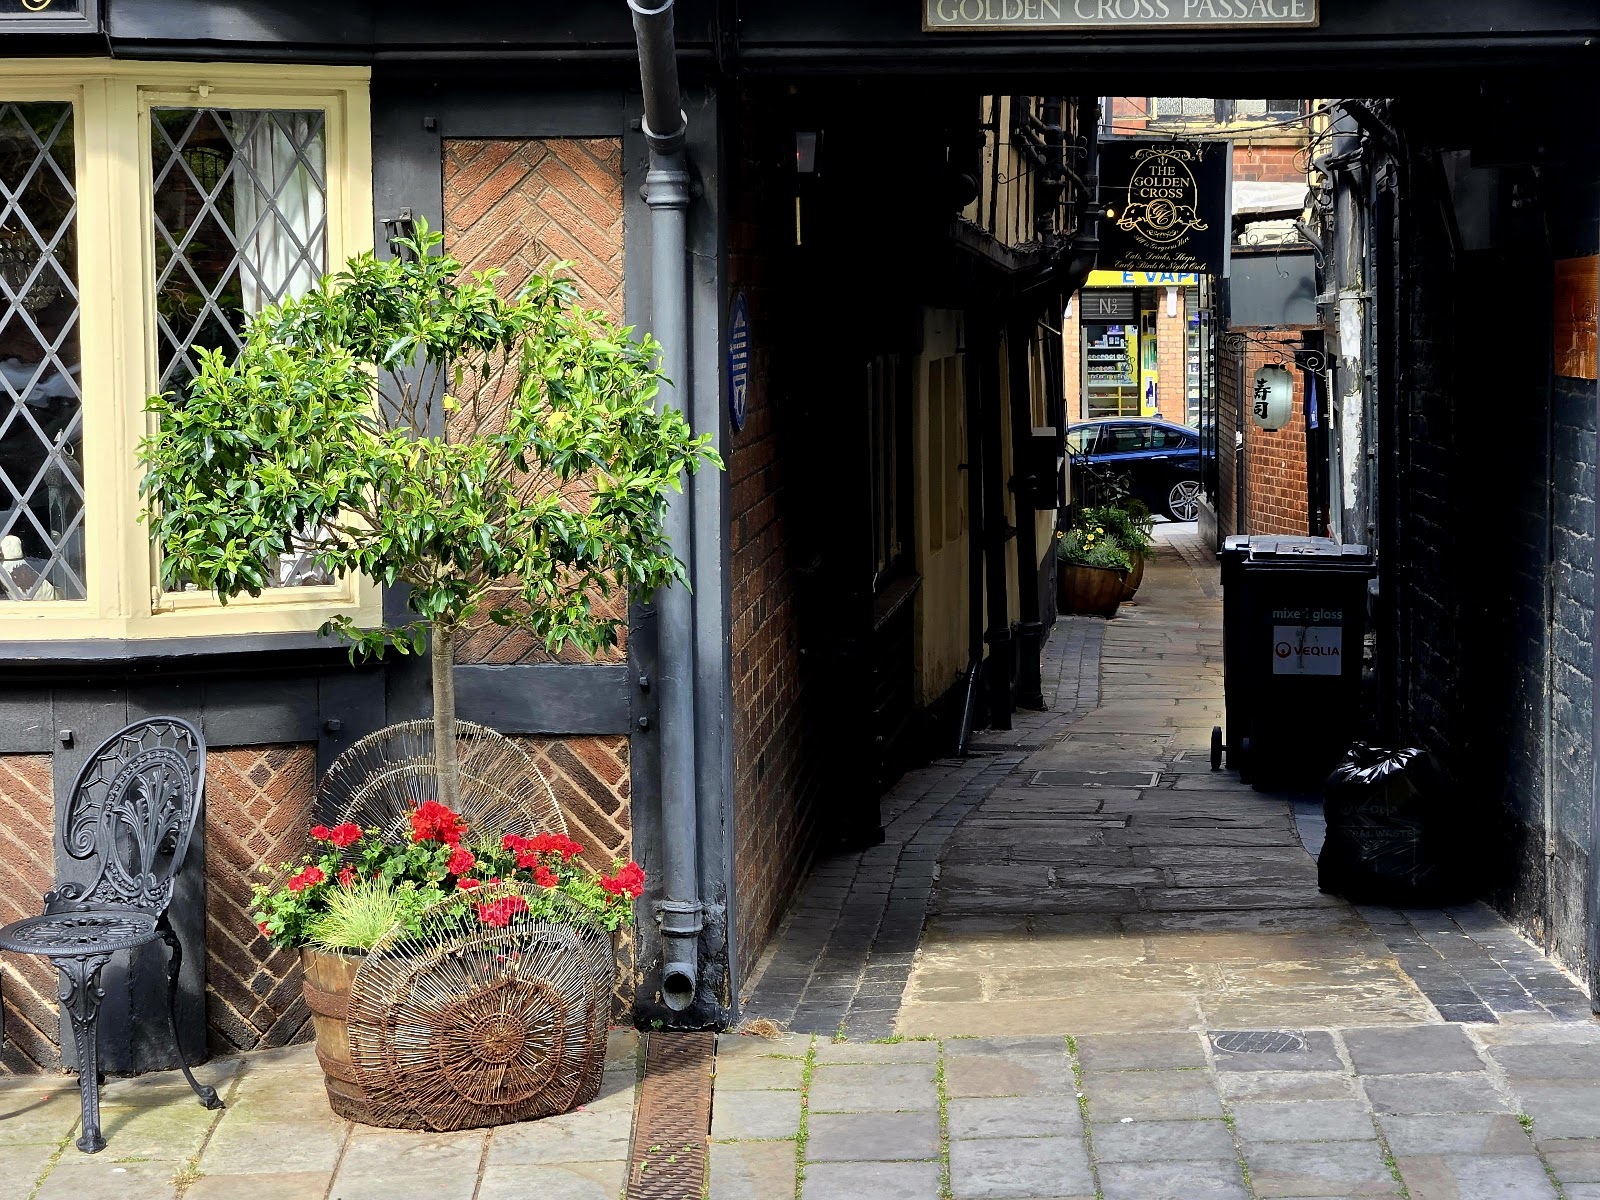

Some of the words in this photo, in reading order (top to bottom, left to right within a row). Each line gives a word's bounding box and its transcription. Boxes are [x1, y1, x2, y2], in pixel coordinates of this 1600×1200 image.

[936, 0, 1061, 21] GOLDEN
[1074, 0, 1170, 20] CROSS
[1183, 0, 1306, 19] PASSAGE
[1149, 166, 1176, 176] THE
[1134, 177, 1190, 188] GOLDEN
[1140, 188, 1184, 199] CROSS
[1115, 260, 1135, 270] Early
[1136, 261, 1158, 269] Birds
[1166, 261, 1189, 272] Night
[1188, 262, 1207, 271] Owls
[1122, 271, 1135, 283] E
[1254, 378, 1272, 419] 寿司
[1312, 607, 1343, 622] glass
